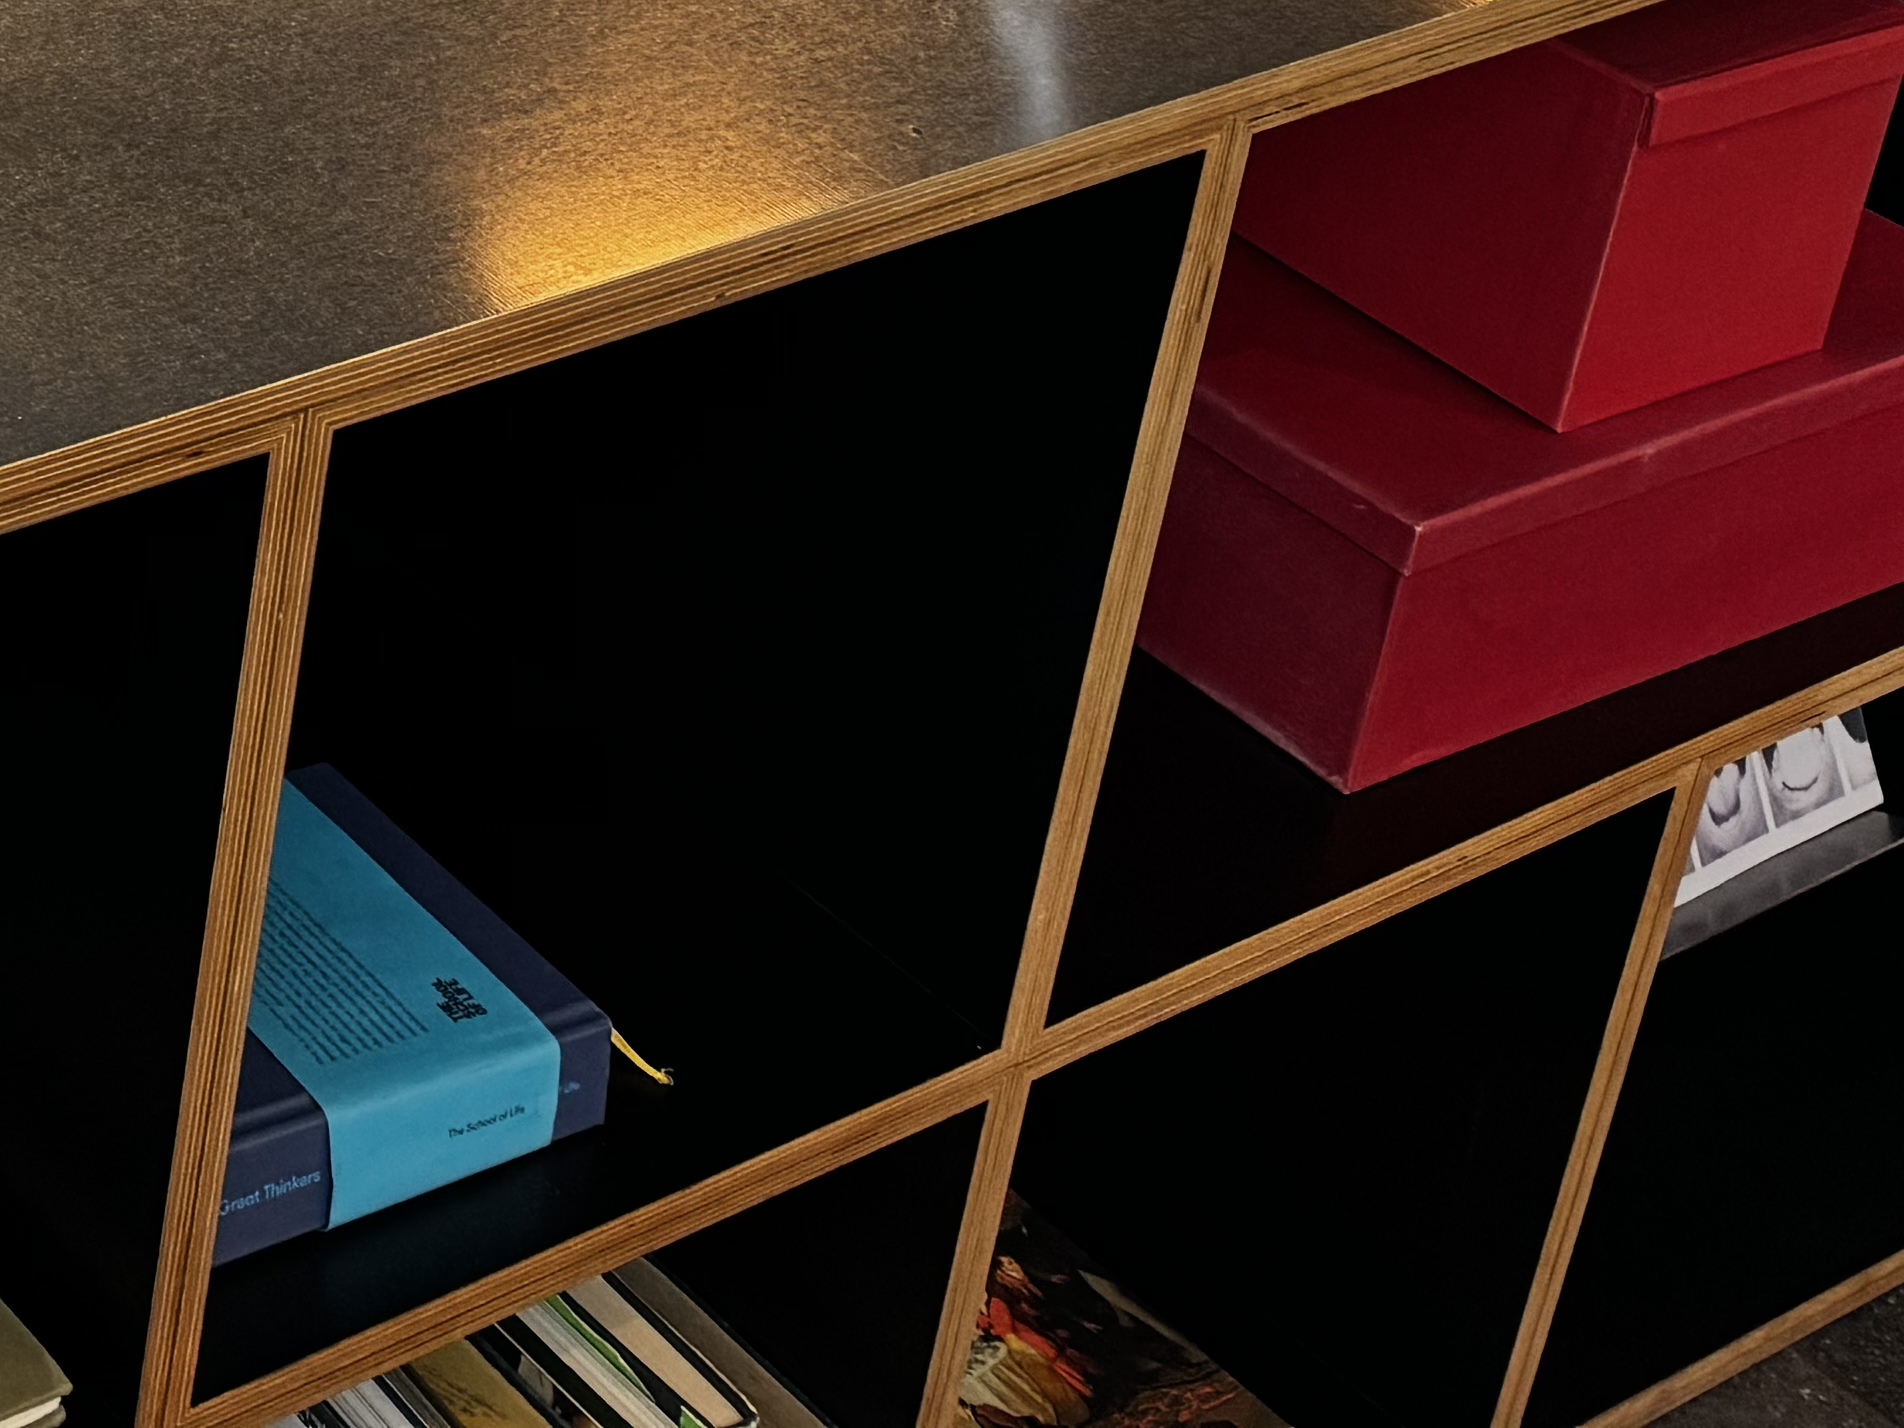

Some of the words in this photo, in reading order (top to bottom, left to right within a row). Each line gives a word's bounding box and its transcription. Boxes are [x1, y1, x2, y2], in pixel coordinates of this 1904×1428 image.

[431, 977, 476, 1018] SCHOOL
[444, 978, 474, 1002] LIFE
[436, 1001, 464, 1023] THE
[220, 1190, 259, 1216] Great
[264, 1171, 321, 1200] Thinkers
